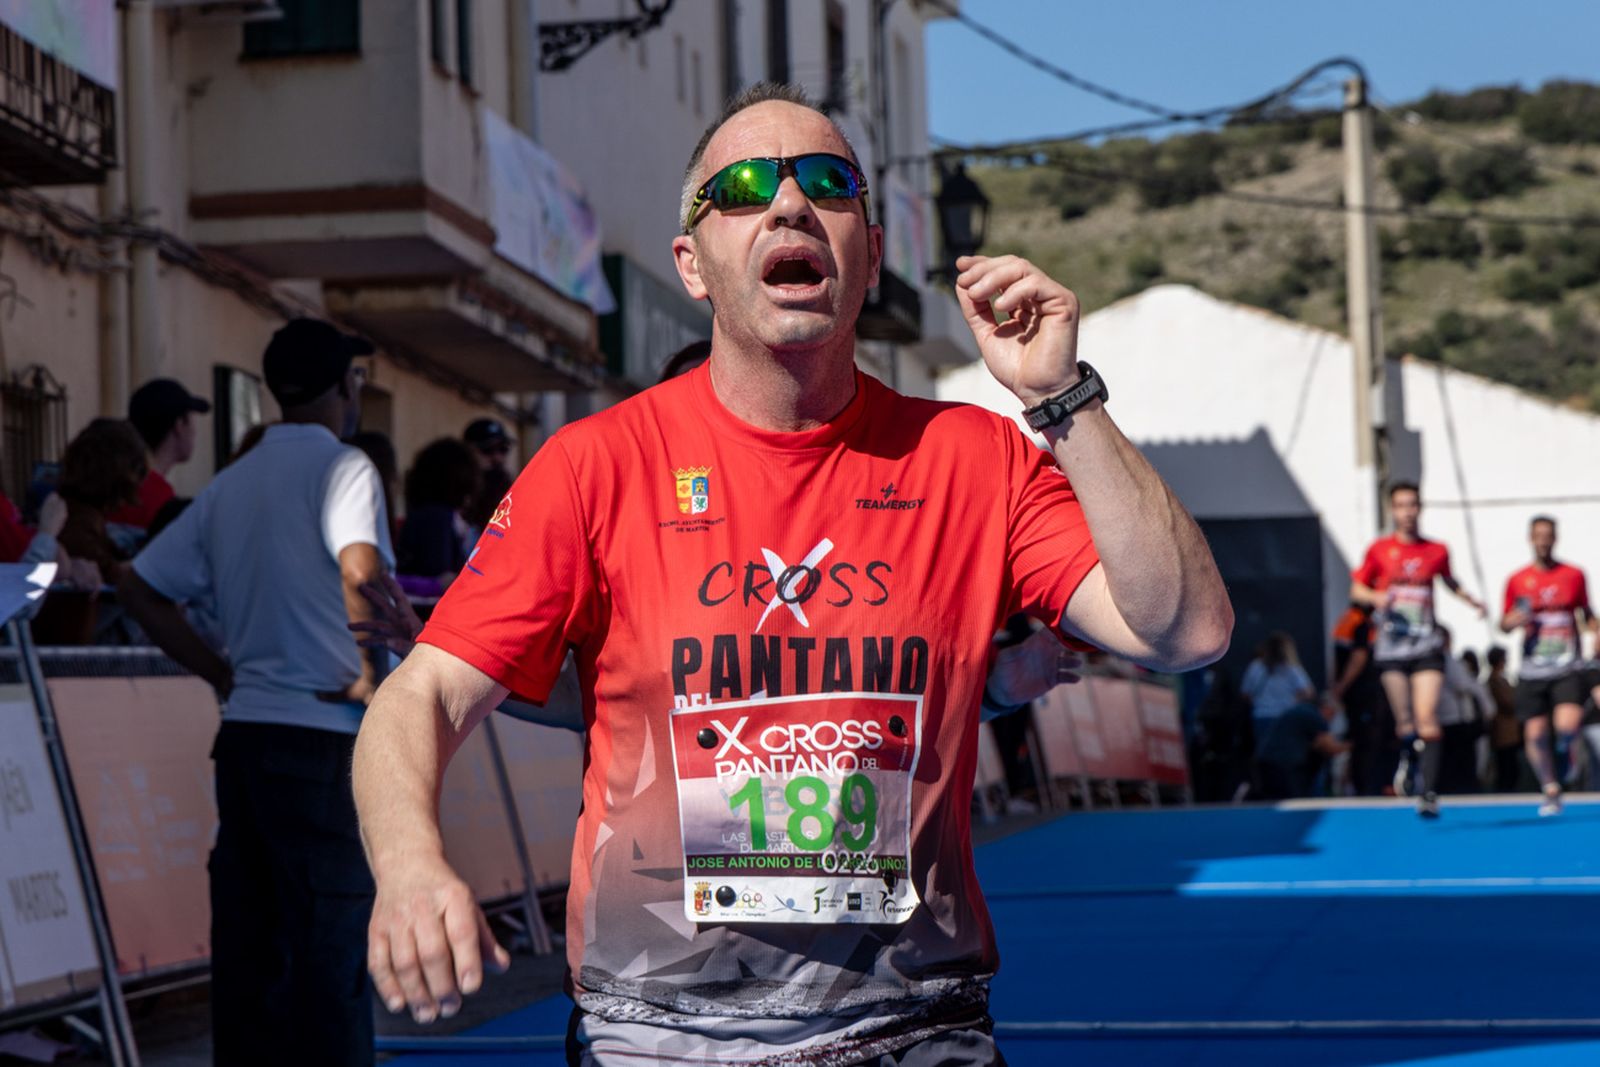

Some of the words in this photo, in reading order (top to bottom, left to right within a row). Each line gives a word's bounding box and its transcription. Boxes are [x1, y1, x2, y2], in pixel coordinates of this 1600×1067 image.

[855, 498, 925, 511] TEAMERGY
[697, 560, 893, 608] CROSS
[671, 633, 929, 699] PANTANO
[709, 716, 753, 760] X
[759, 719, 883, 754] CROSS
[713, 750, 860, 784] PANTANO
[861, 757, 880, 770] DEL
[729, 773, 879, 853] 189
[721, 832, 747, 844] LAS
[688, 856, 725, 869] JOSE
[728, 856, 791, 869] ANTONIO
[794, 856, 813, 869] DE
